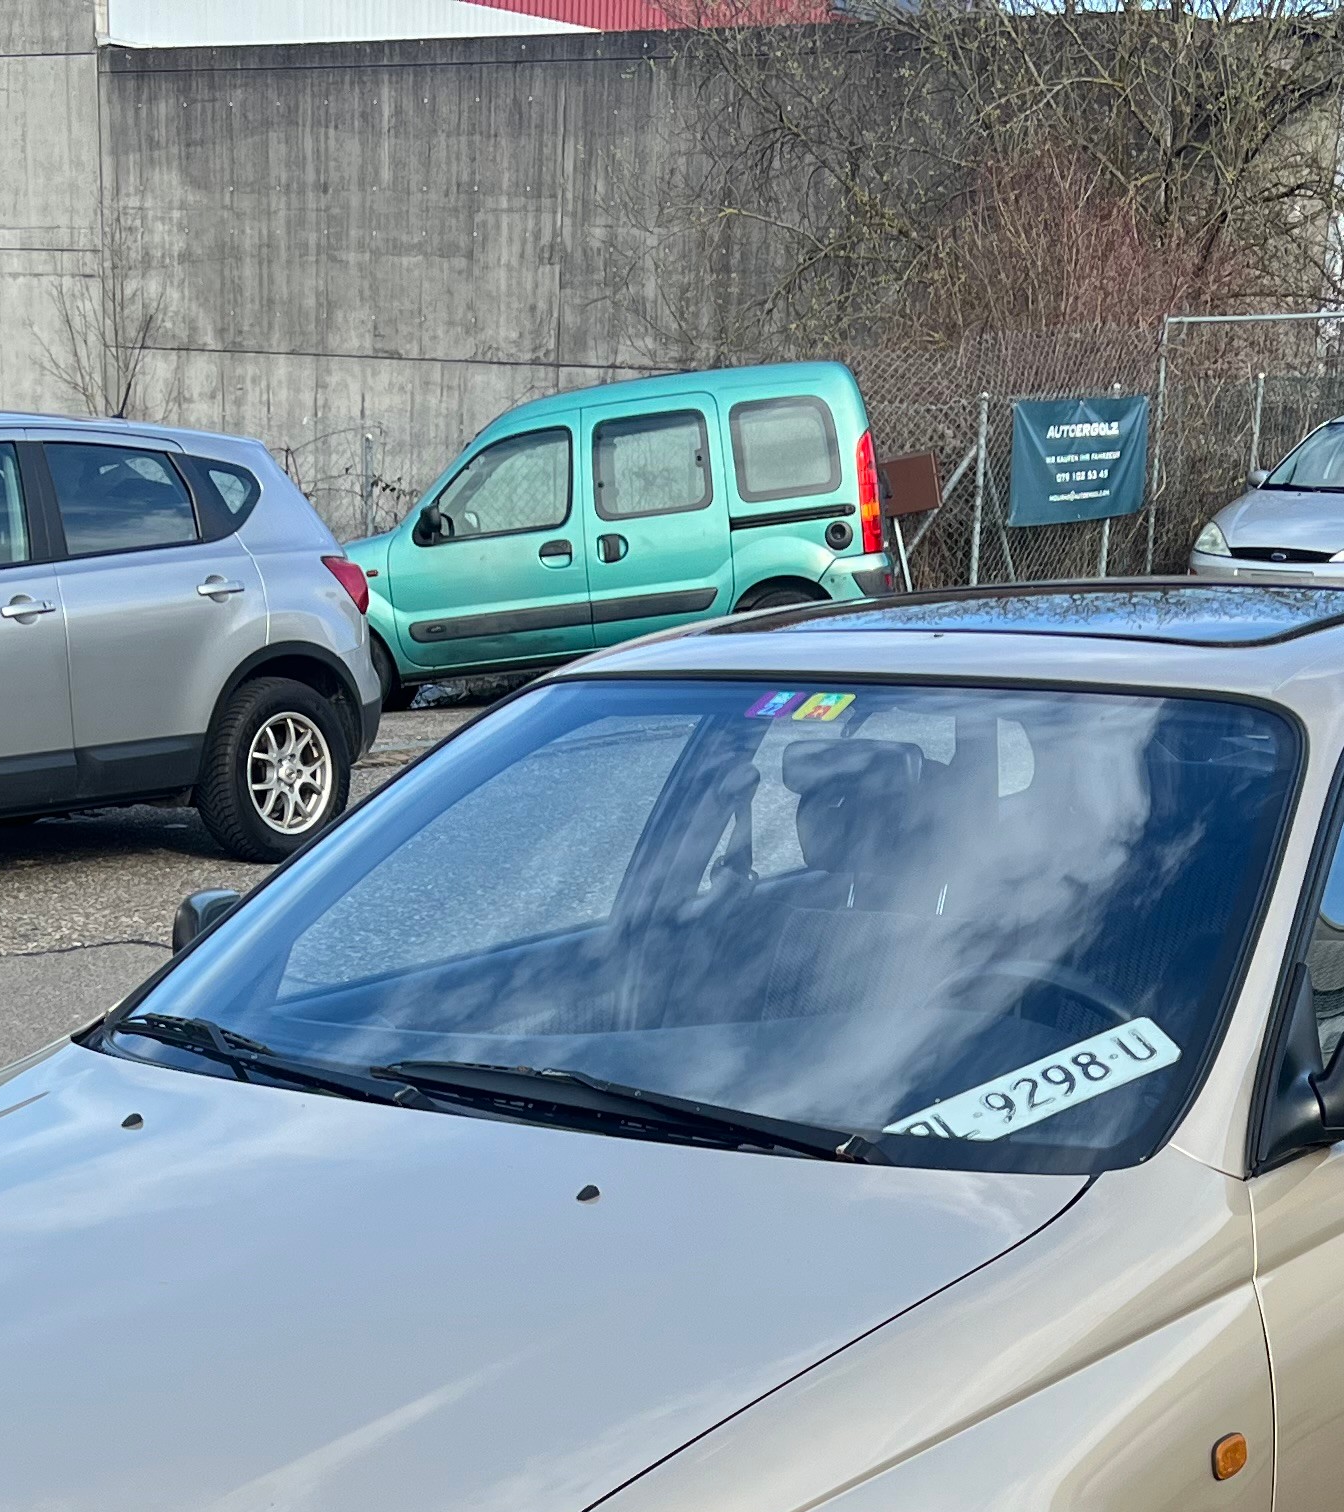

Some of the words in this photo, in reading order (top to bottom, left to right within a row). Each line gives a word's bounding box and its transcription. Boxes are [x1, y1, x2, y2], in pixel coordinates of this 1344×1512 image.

[1046, 421, 1120, 439] AUTOERGOLZ
[980, 1051, 1112, 1125] 9298
[1115, 1028, 1160, 1063] U
